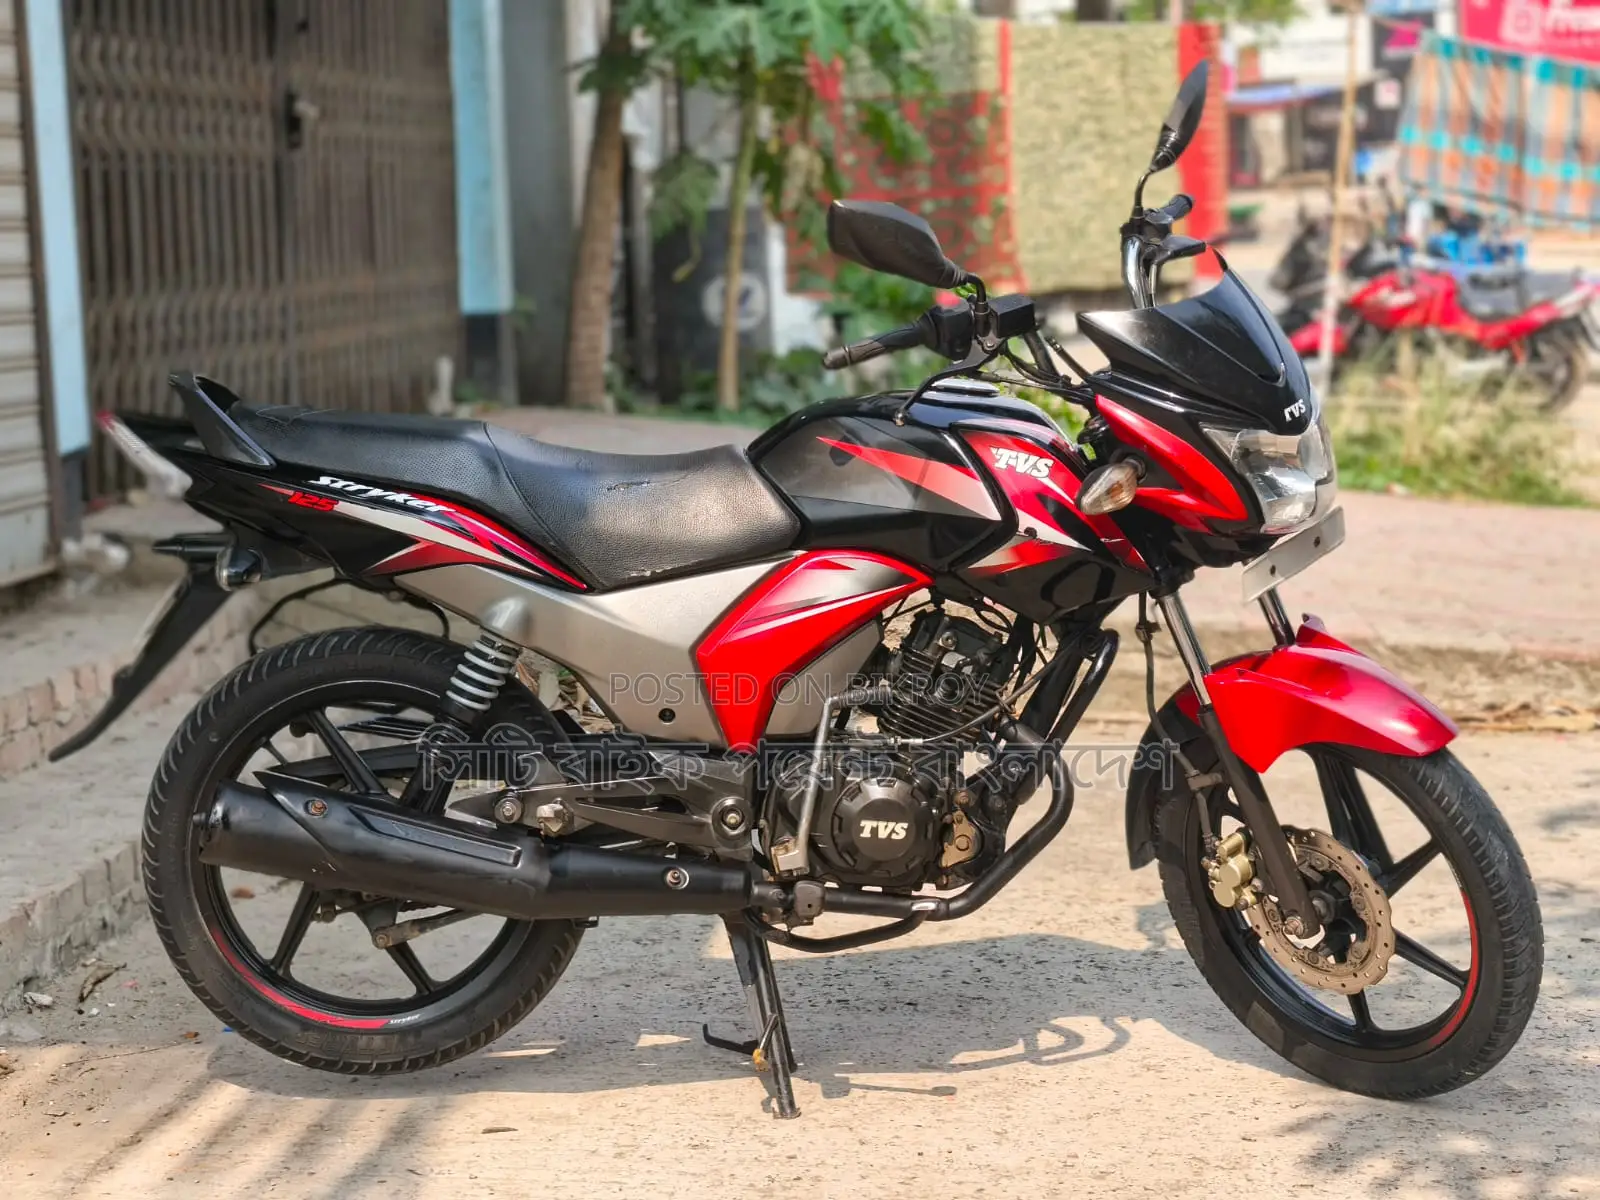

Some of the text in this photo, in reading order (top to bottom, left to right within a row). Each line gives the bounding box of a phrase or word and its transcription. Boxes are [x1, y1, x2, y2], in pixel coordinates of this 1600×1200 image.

[1284, 399, 1306, 422] TVS
[990, 447, 1054, 478] TVS
[287, 491, 340, 512] 125
[306, 476, 456, 513] Stryker
[859, 820, 909, 840] TVS
